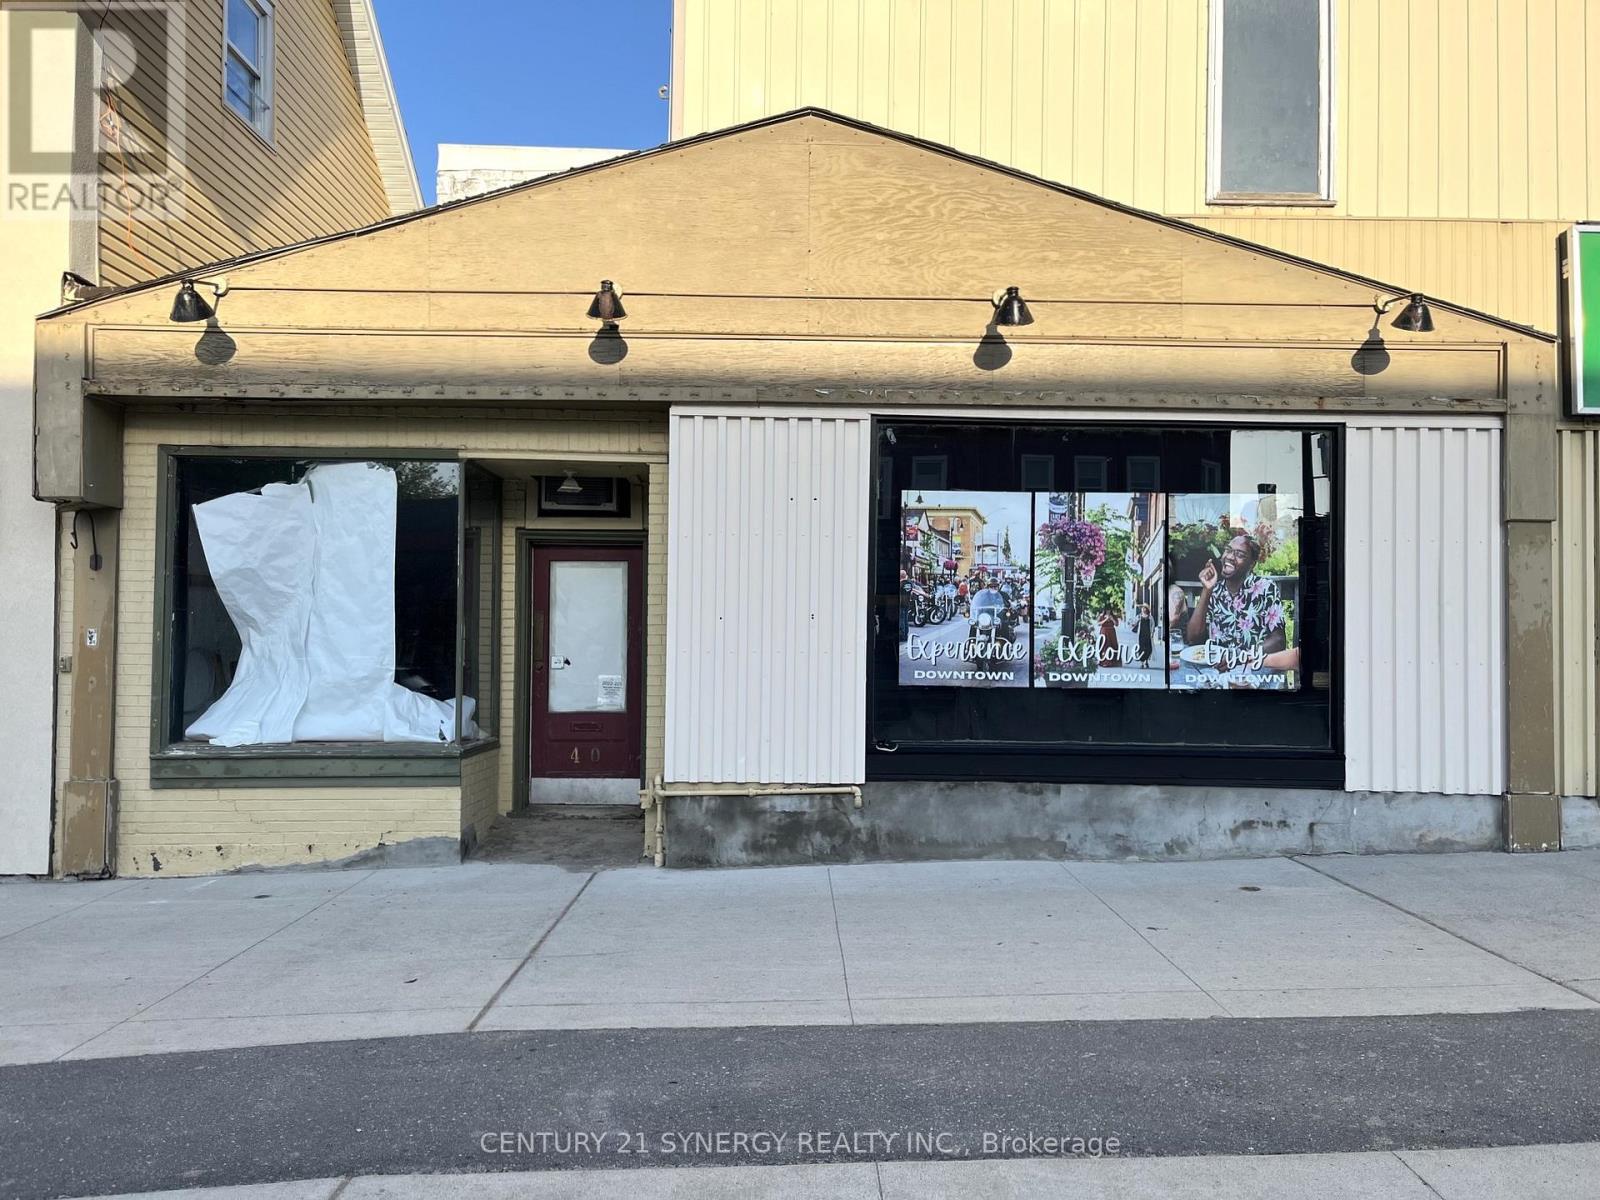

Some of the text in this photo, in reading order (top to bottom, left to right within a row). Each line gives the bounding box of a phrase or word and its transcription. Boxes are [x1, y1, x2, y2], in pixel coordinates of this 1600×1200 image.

[905, 634, 1027, 666] Experience
[1056, 634, 1146, 667] Explore
[1203, 638, 1268, 671] Enjoy
[914, 669, 1014, 681] DOWNTOWN
[1049, 671, 1151, 683] DOWNTOWN
[1185, 673, 1285, 684] DOWNTOWN
[570, 747, 600, 763] 40
